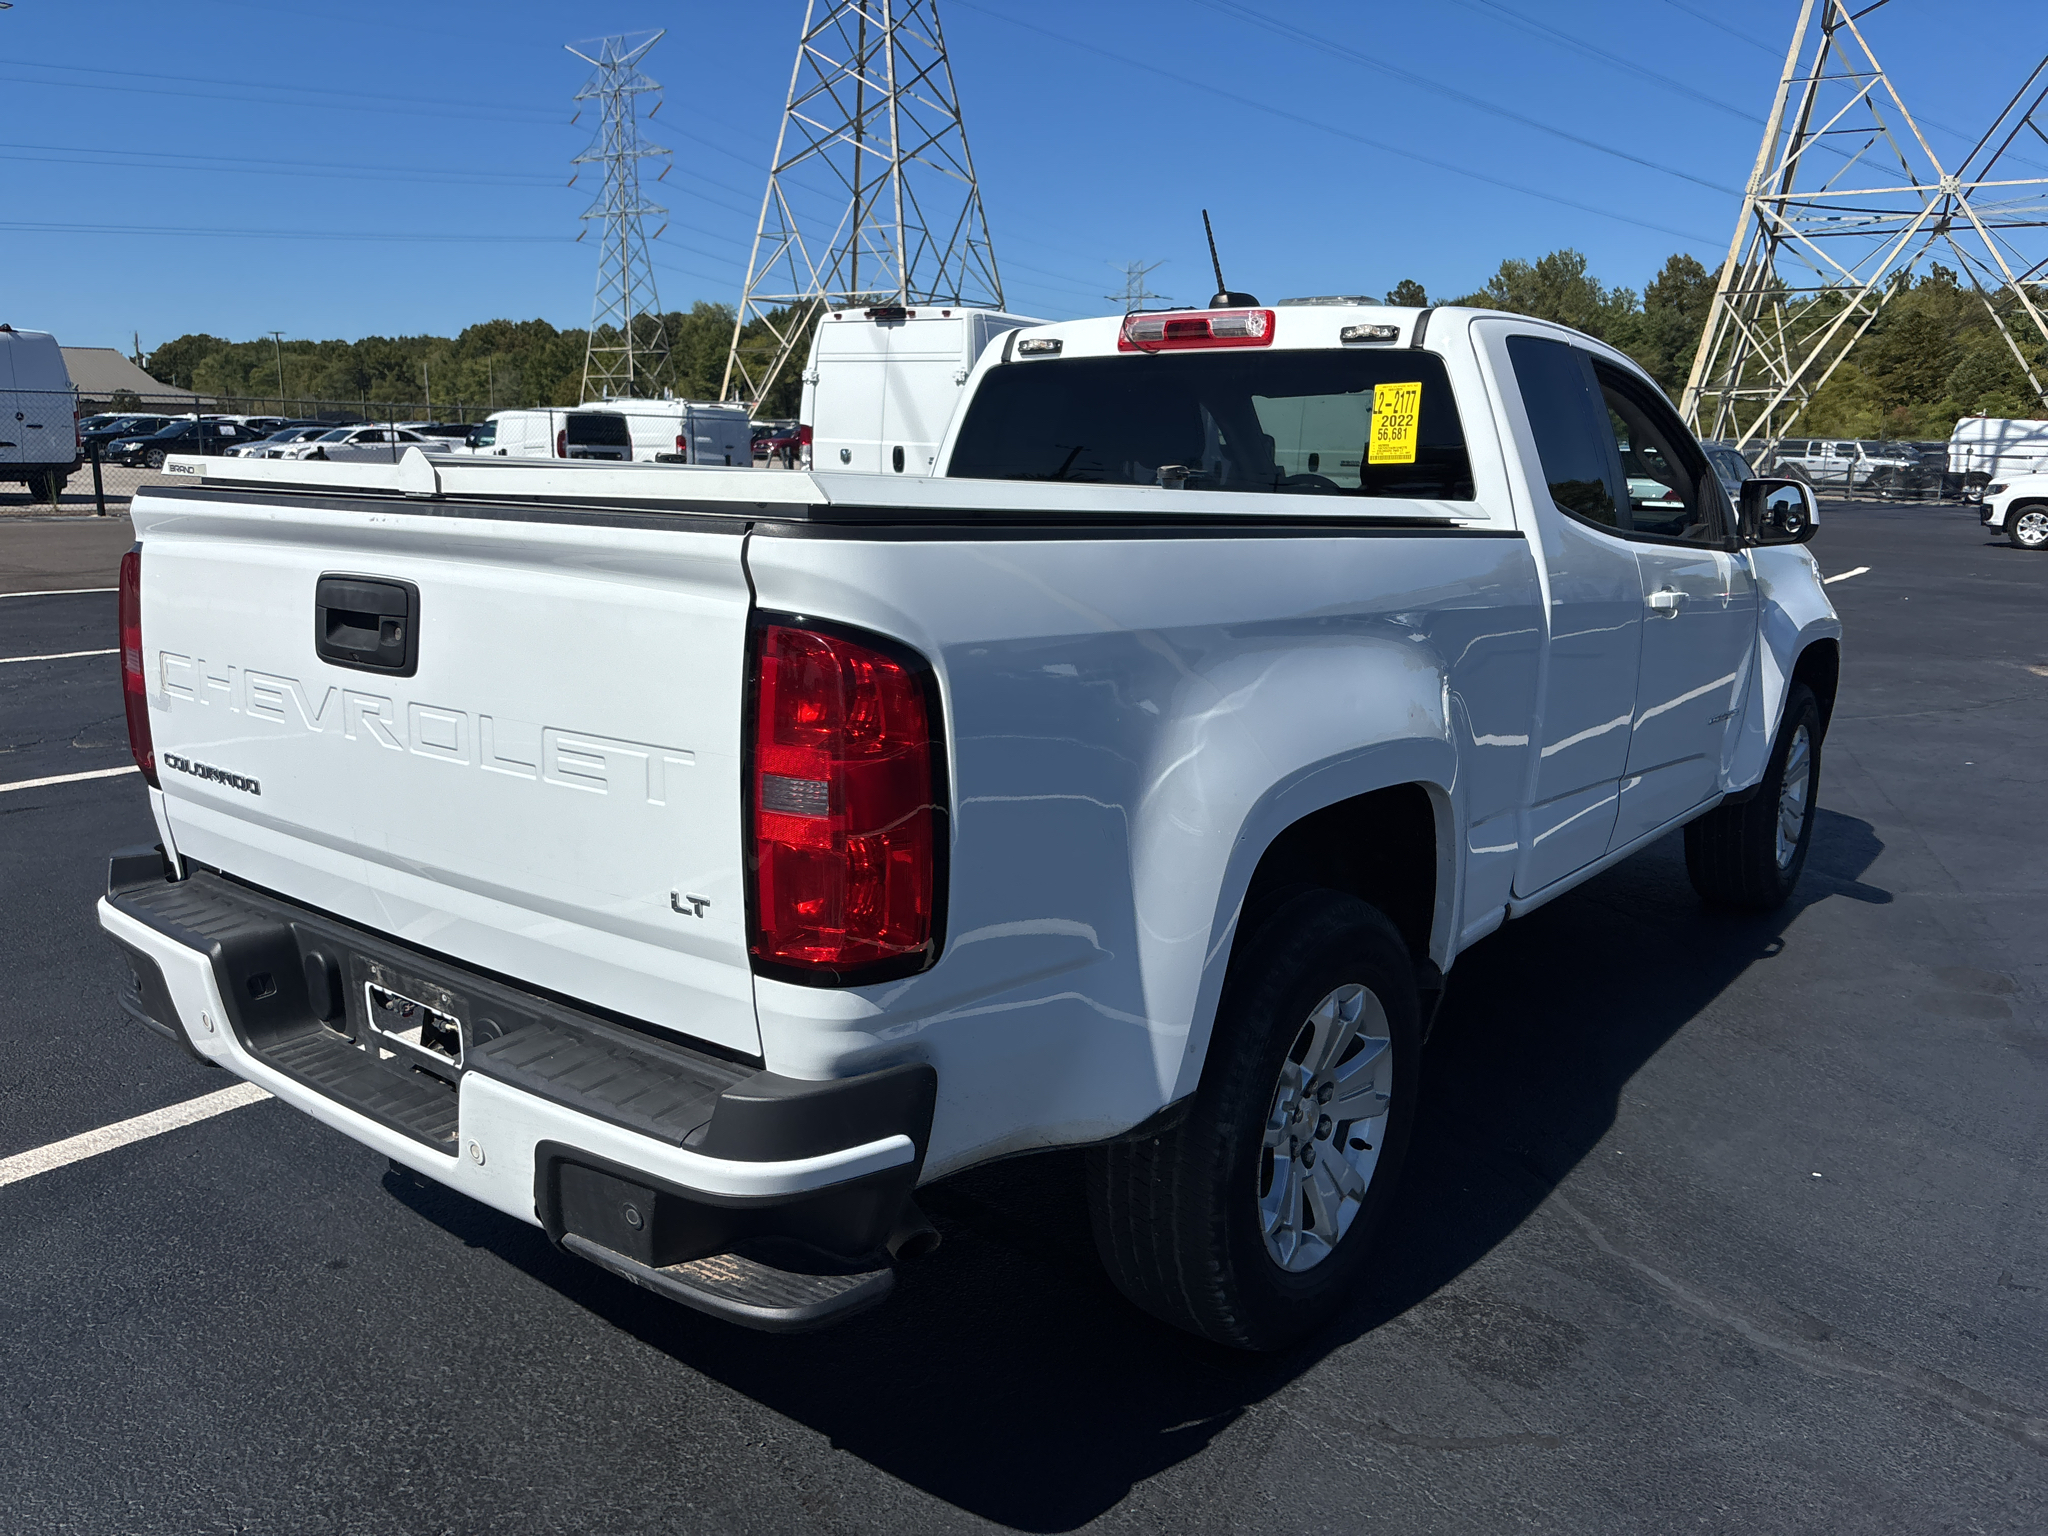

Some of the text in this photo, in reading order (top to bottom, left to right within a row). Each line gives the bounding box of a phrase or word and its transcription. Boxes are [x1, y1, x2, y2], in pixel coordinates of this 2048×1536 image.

[1381, 415, 1414, 428] 2022
[1377, 427, 1408, 443] 56,681
[169, 464, 195, 475] BRAND
[159, 650, 697, 806] CHEVROLET
[163, 751, 263, 797] COLORADO
[670, 887, 711, 919] LT
